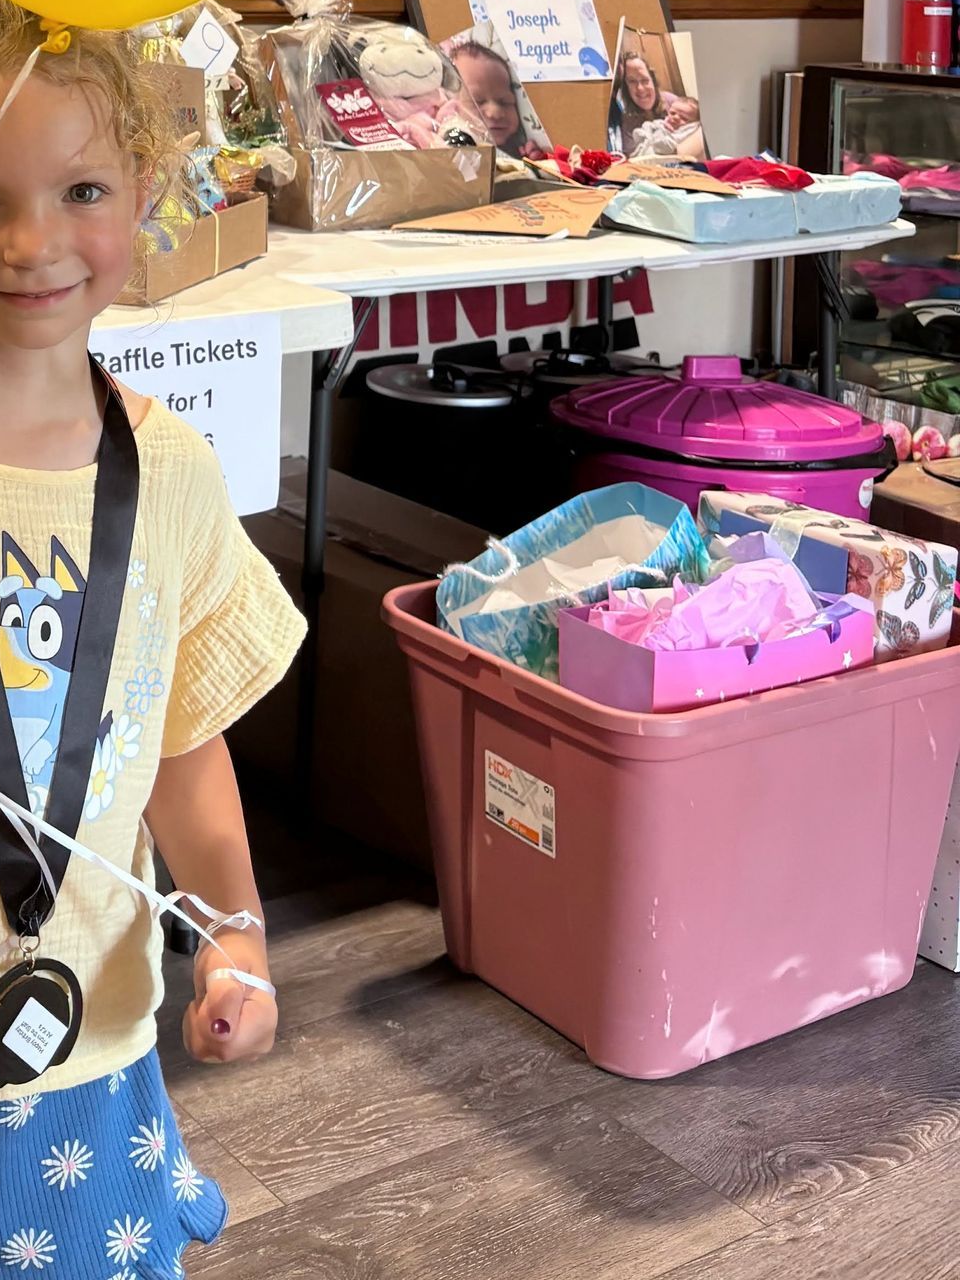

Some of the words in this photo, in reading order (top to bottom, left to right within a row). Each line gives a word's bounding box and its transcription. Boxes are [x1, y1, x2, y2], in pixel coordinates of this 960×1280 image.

[506, 9, 560, 34] Joseph
[201, 22, 225, 70] 9
[513, 38, 572, 62] Leggett
[170, 338, 258, 367] Tickets
[166, 393, 197, 412] for
[204, 389, 213, 409] 1
